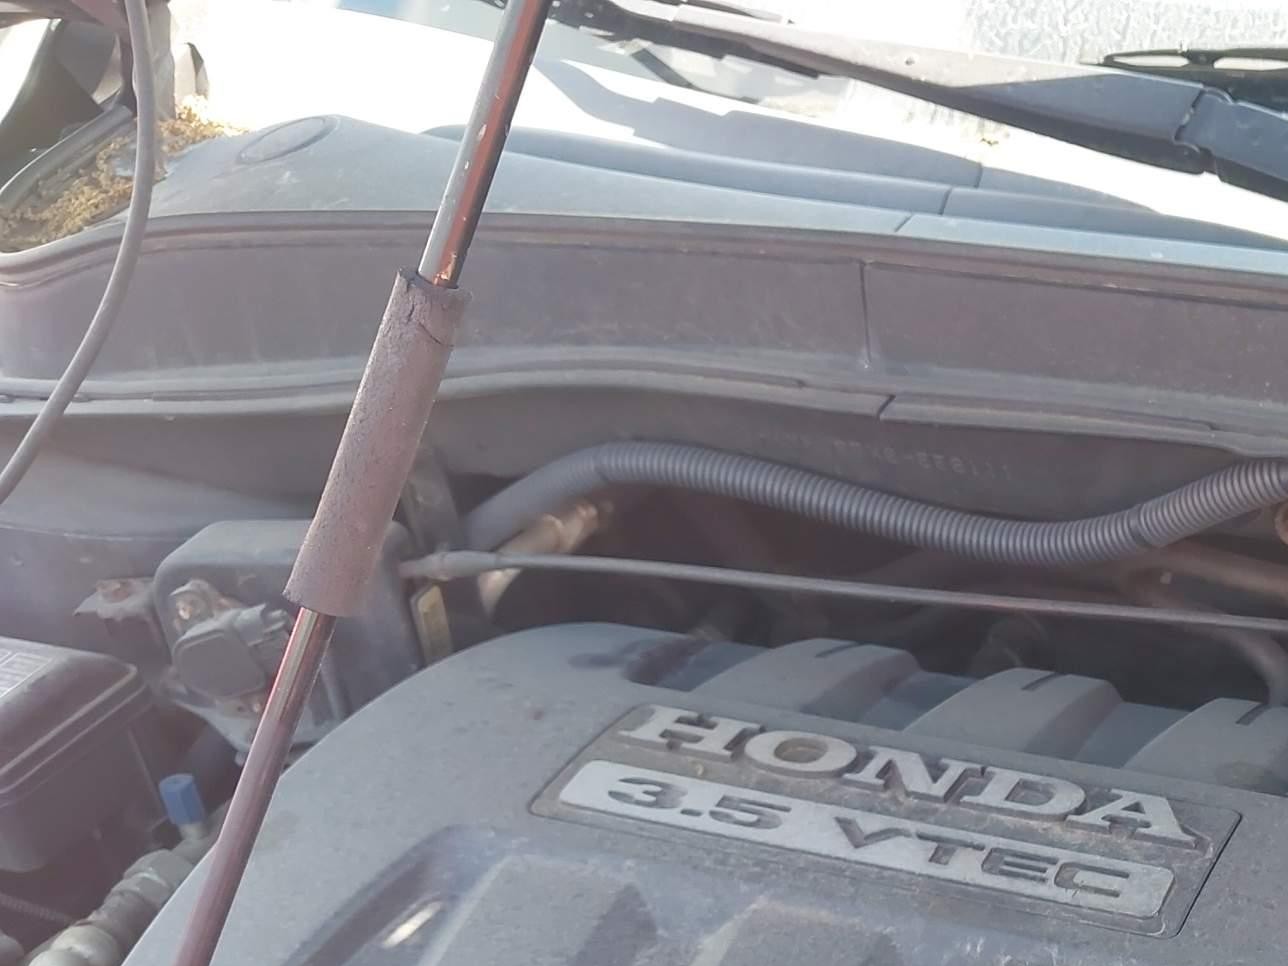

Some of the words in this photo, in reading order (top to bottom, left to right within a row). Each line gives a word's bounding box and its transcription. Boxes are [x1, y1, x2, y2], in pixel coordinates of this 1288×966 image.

[606, 776, 792, 830] 3.5
[834, 816, 1131, 898] VTEC
[616, 703, 1204, 850] HONDA
